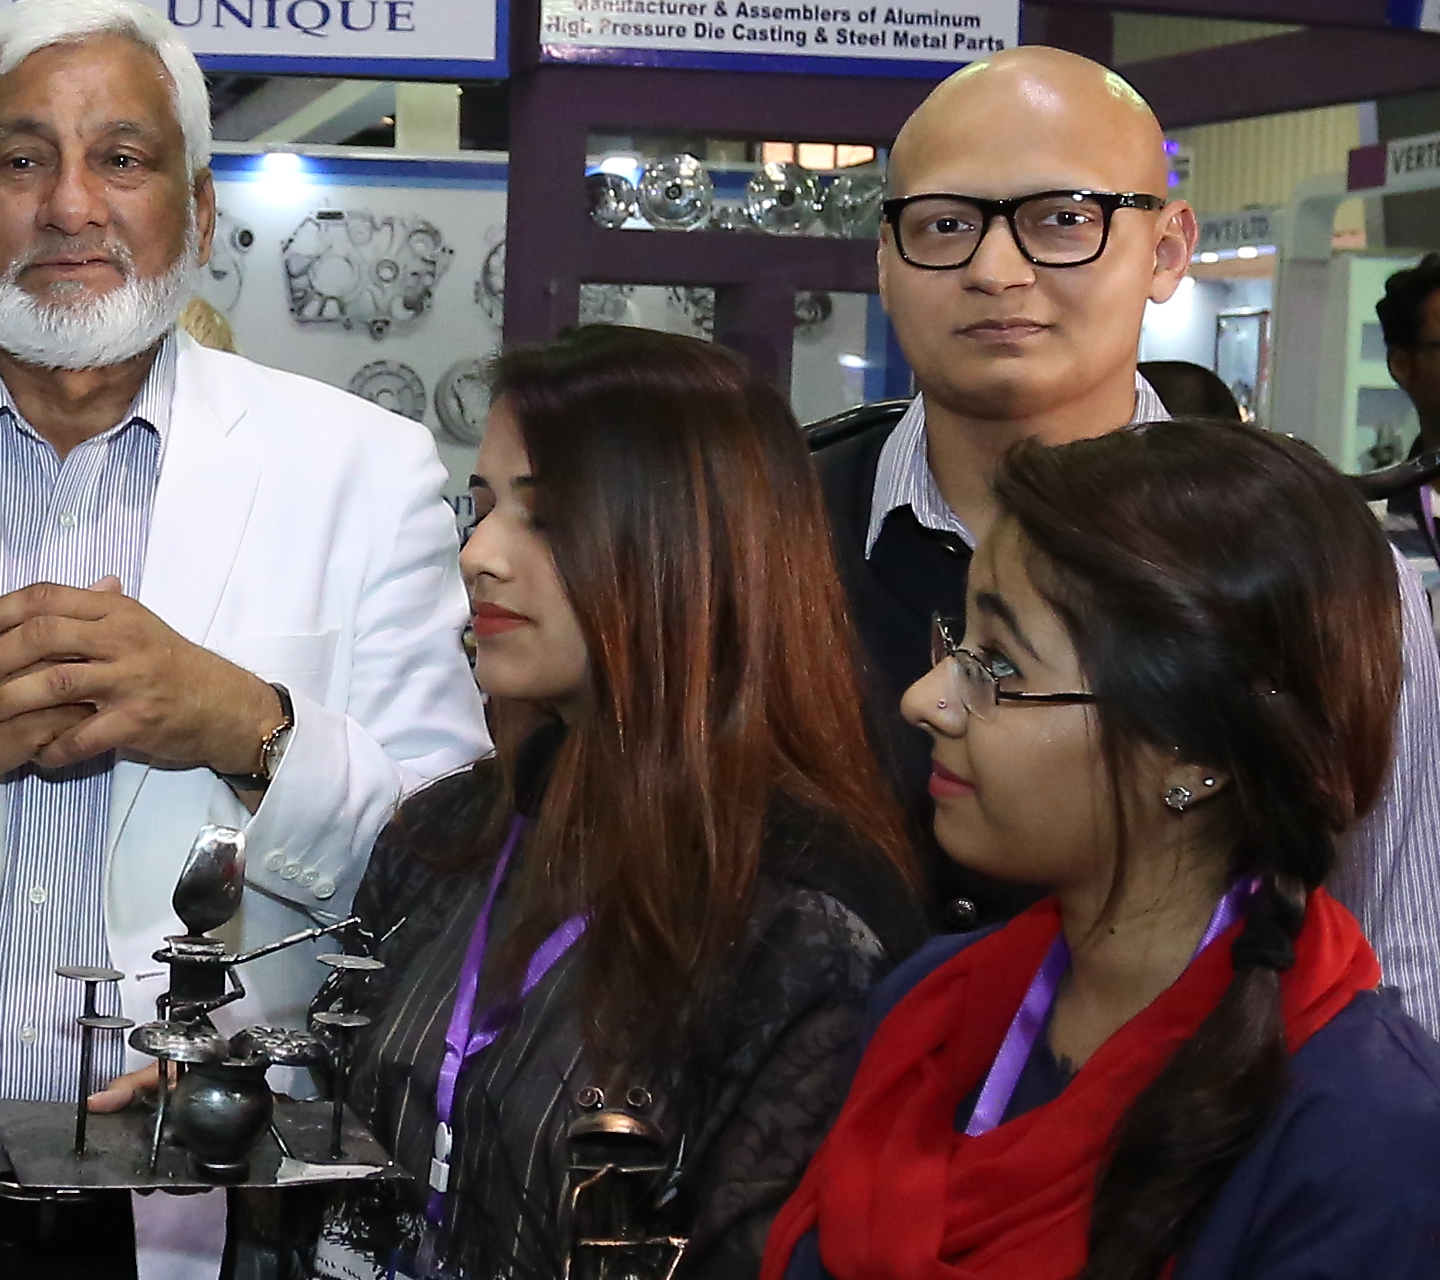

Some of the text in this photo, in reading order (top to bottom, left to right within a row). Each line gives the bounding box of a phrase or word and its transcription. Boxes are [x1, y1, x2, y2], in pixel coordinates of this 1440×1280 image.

[714, 0, 728, 17] &
[736, 2, 851, 23] Assemblers
[858, 7, 877, 23] of
[884, 8, 981, 28] Aluminum
[599, 19, 687, 38] Pressure
[694, 22, 726, 39] Die
[732, 24, 807, 47] Casting
[814, 27, 828, 44] &
[836, 28, 886, 46] Steel
[894, 30, 947, 49] Metal
[954, 33, 1005, 52] Parts
